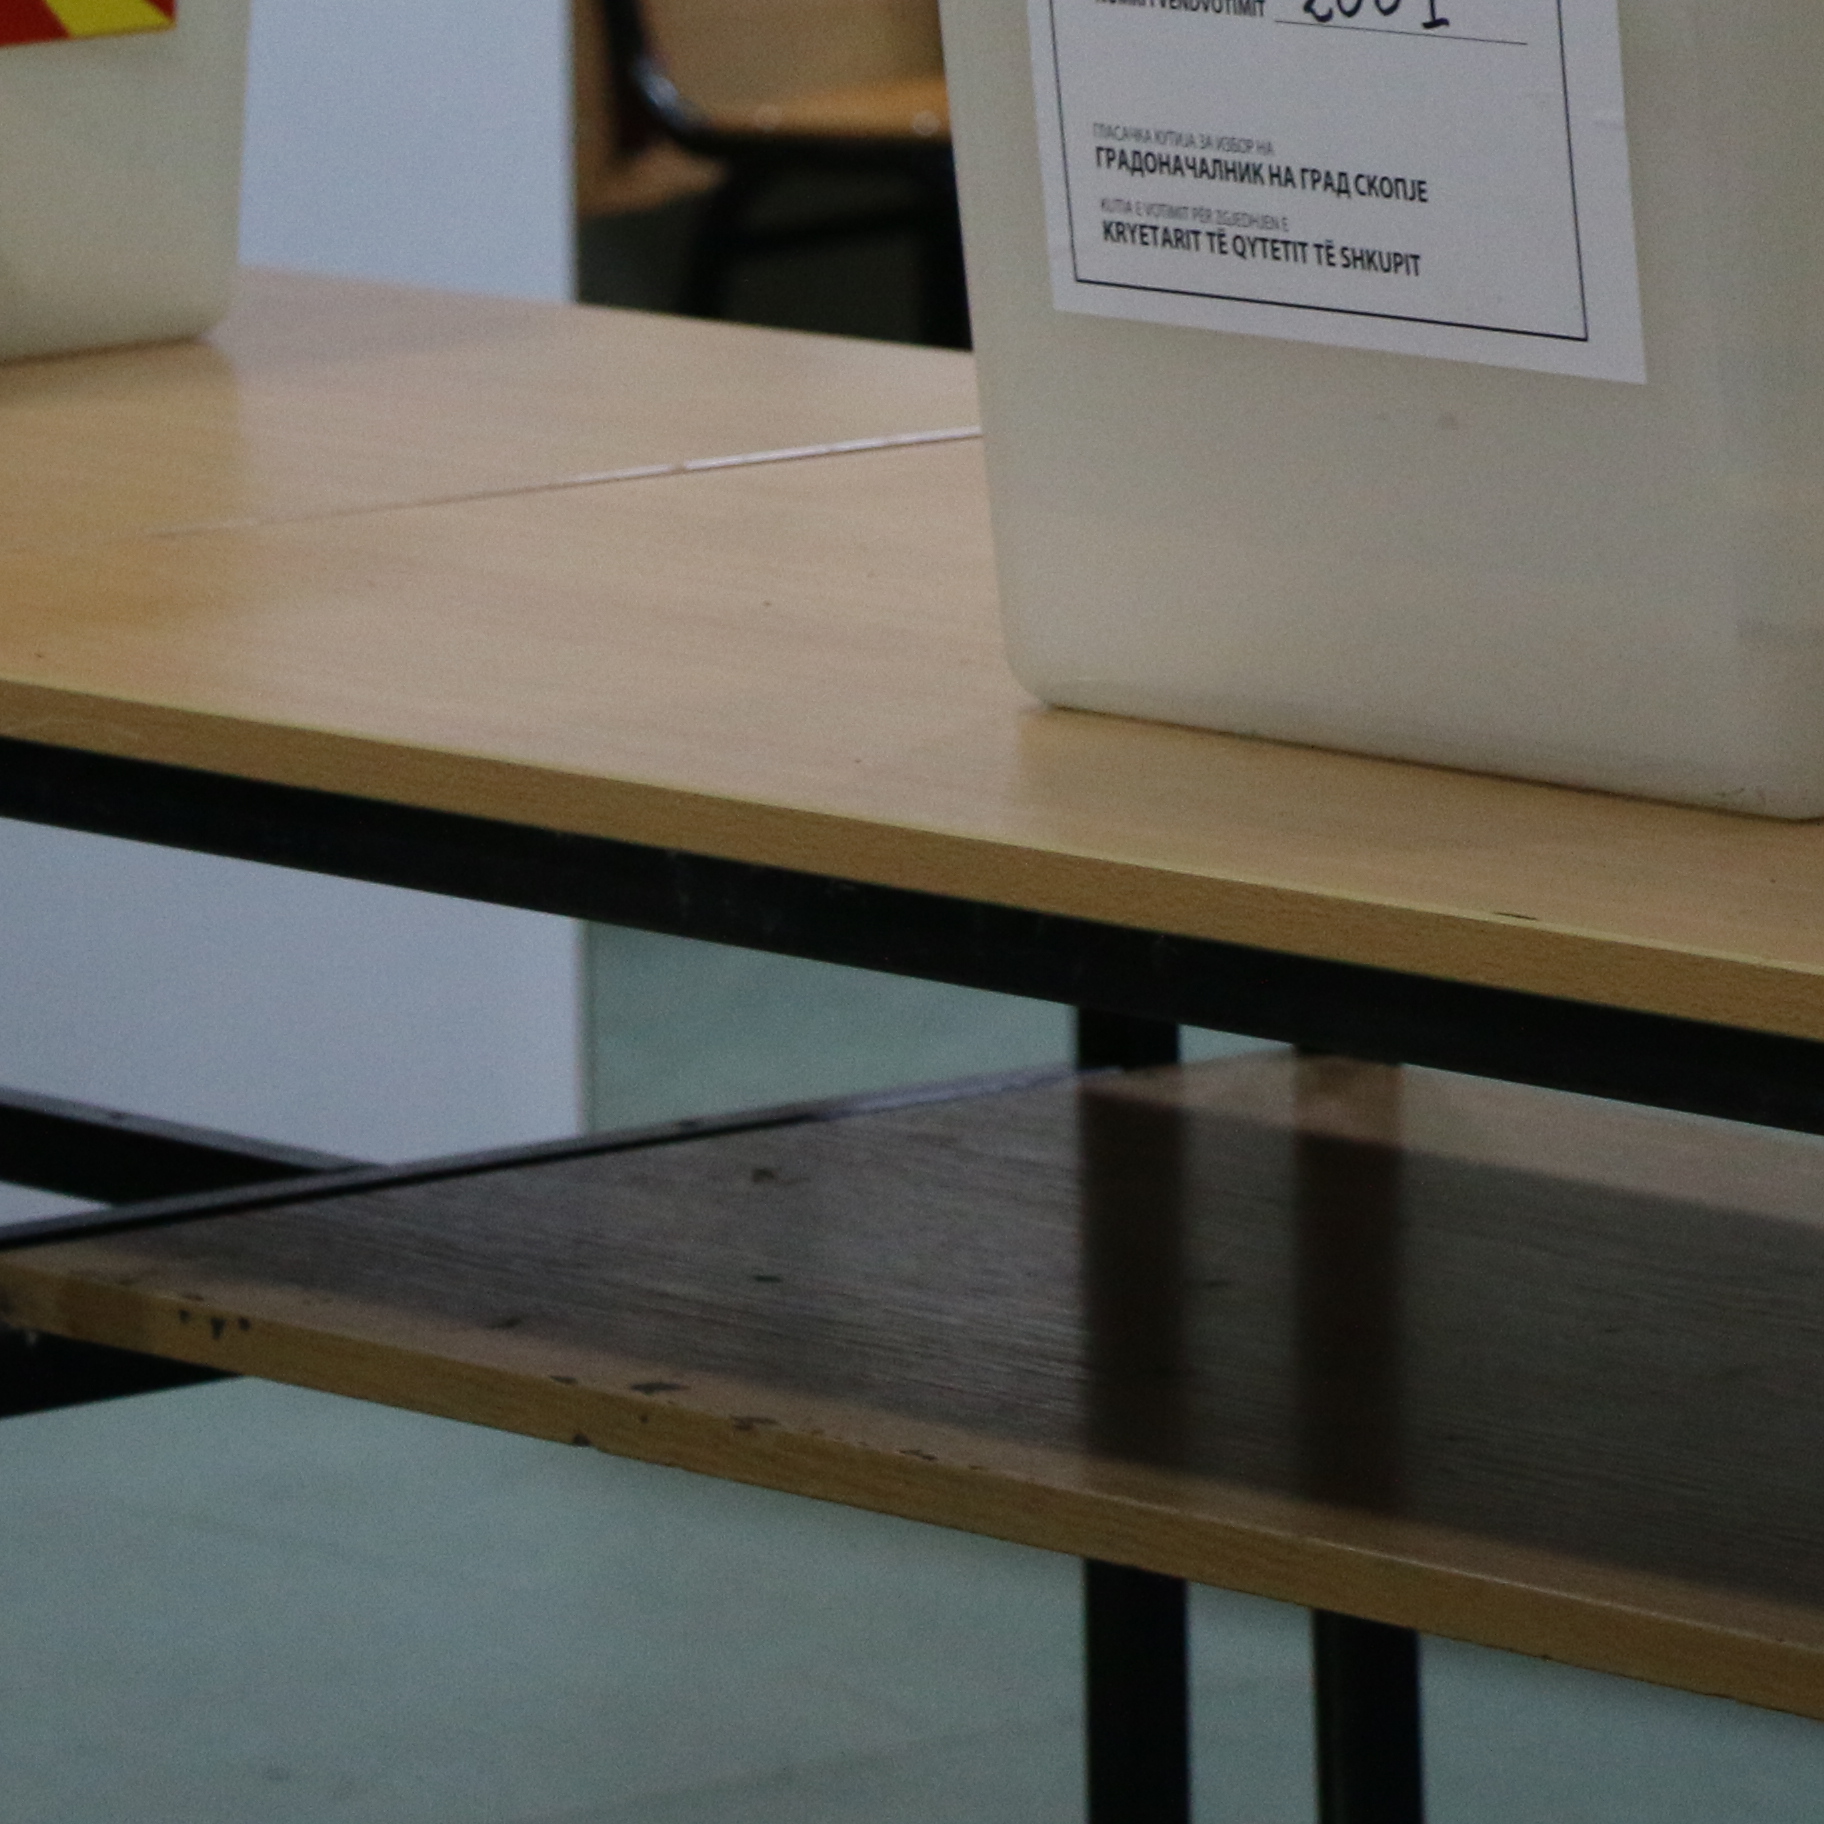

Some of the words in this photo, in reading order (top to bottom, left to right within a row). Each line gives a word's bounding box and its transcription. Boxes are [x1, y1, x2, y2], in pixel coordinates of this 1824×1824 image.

[1199, 135, 1214, 150] ЗА
[1095, 146, 1265, 185] ГРАДОНАЧАЛНИК
[1268, 163, 1296, 189] НА
[1299, 167, 1351, 199] ГРАД
[1354, 174, 1429, 204] СКОПЈЕ
[1102, 219, 1201, 252] KRYETARIT
[1206, 228, 1228, 255] TË
[1233, 233, 1310, 266] QYTETIT
[1313, 240, 1337, 267] TË
[1340, 246, 1422, 277] SHKUPIT
